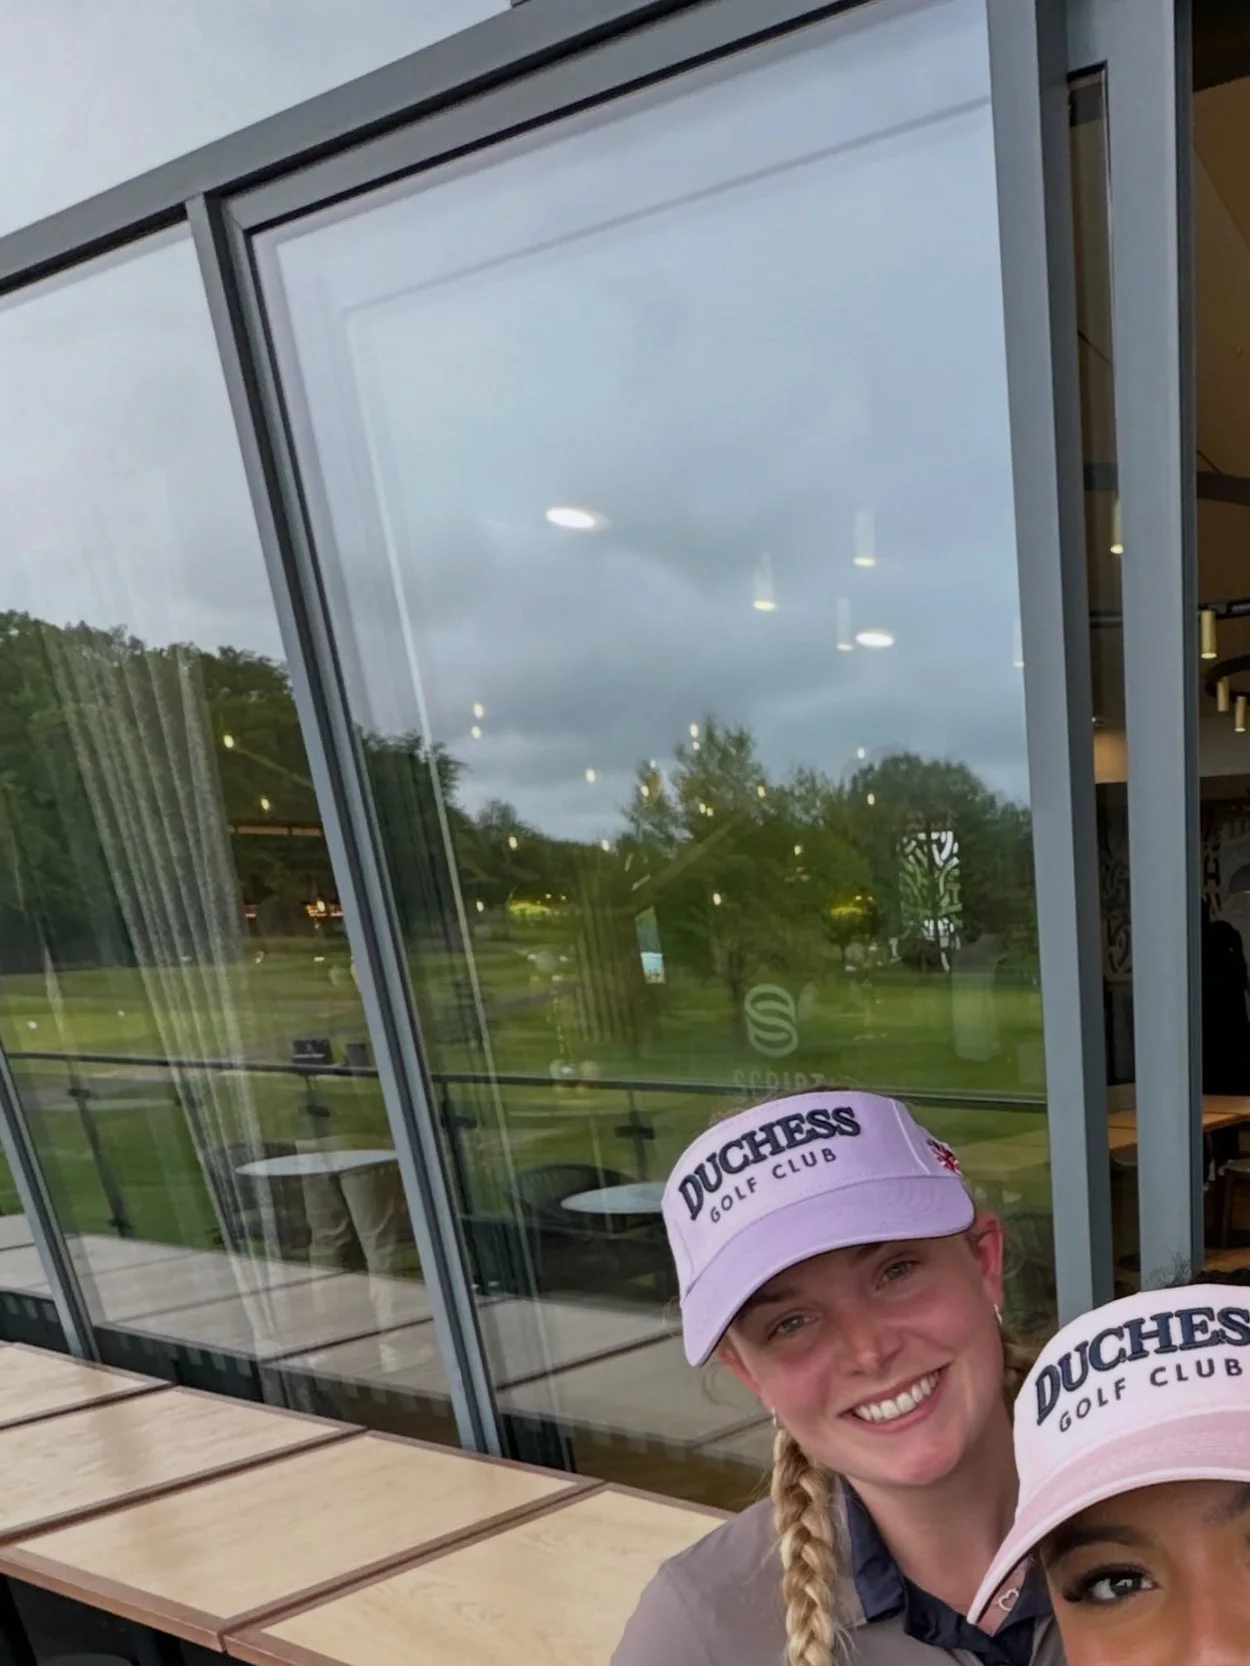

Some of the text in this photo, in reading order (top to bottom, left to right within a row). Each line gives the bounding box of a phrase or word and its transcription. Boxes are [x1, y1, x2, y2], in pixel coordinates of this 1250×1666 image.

[678, 1106, 861, 1222] DUCHESS
[709, 1147, 837, 1224] GOLF CLUB
[1058, 1357, 1244, 1433] GOLF CLUB
